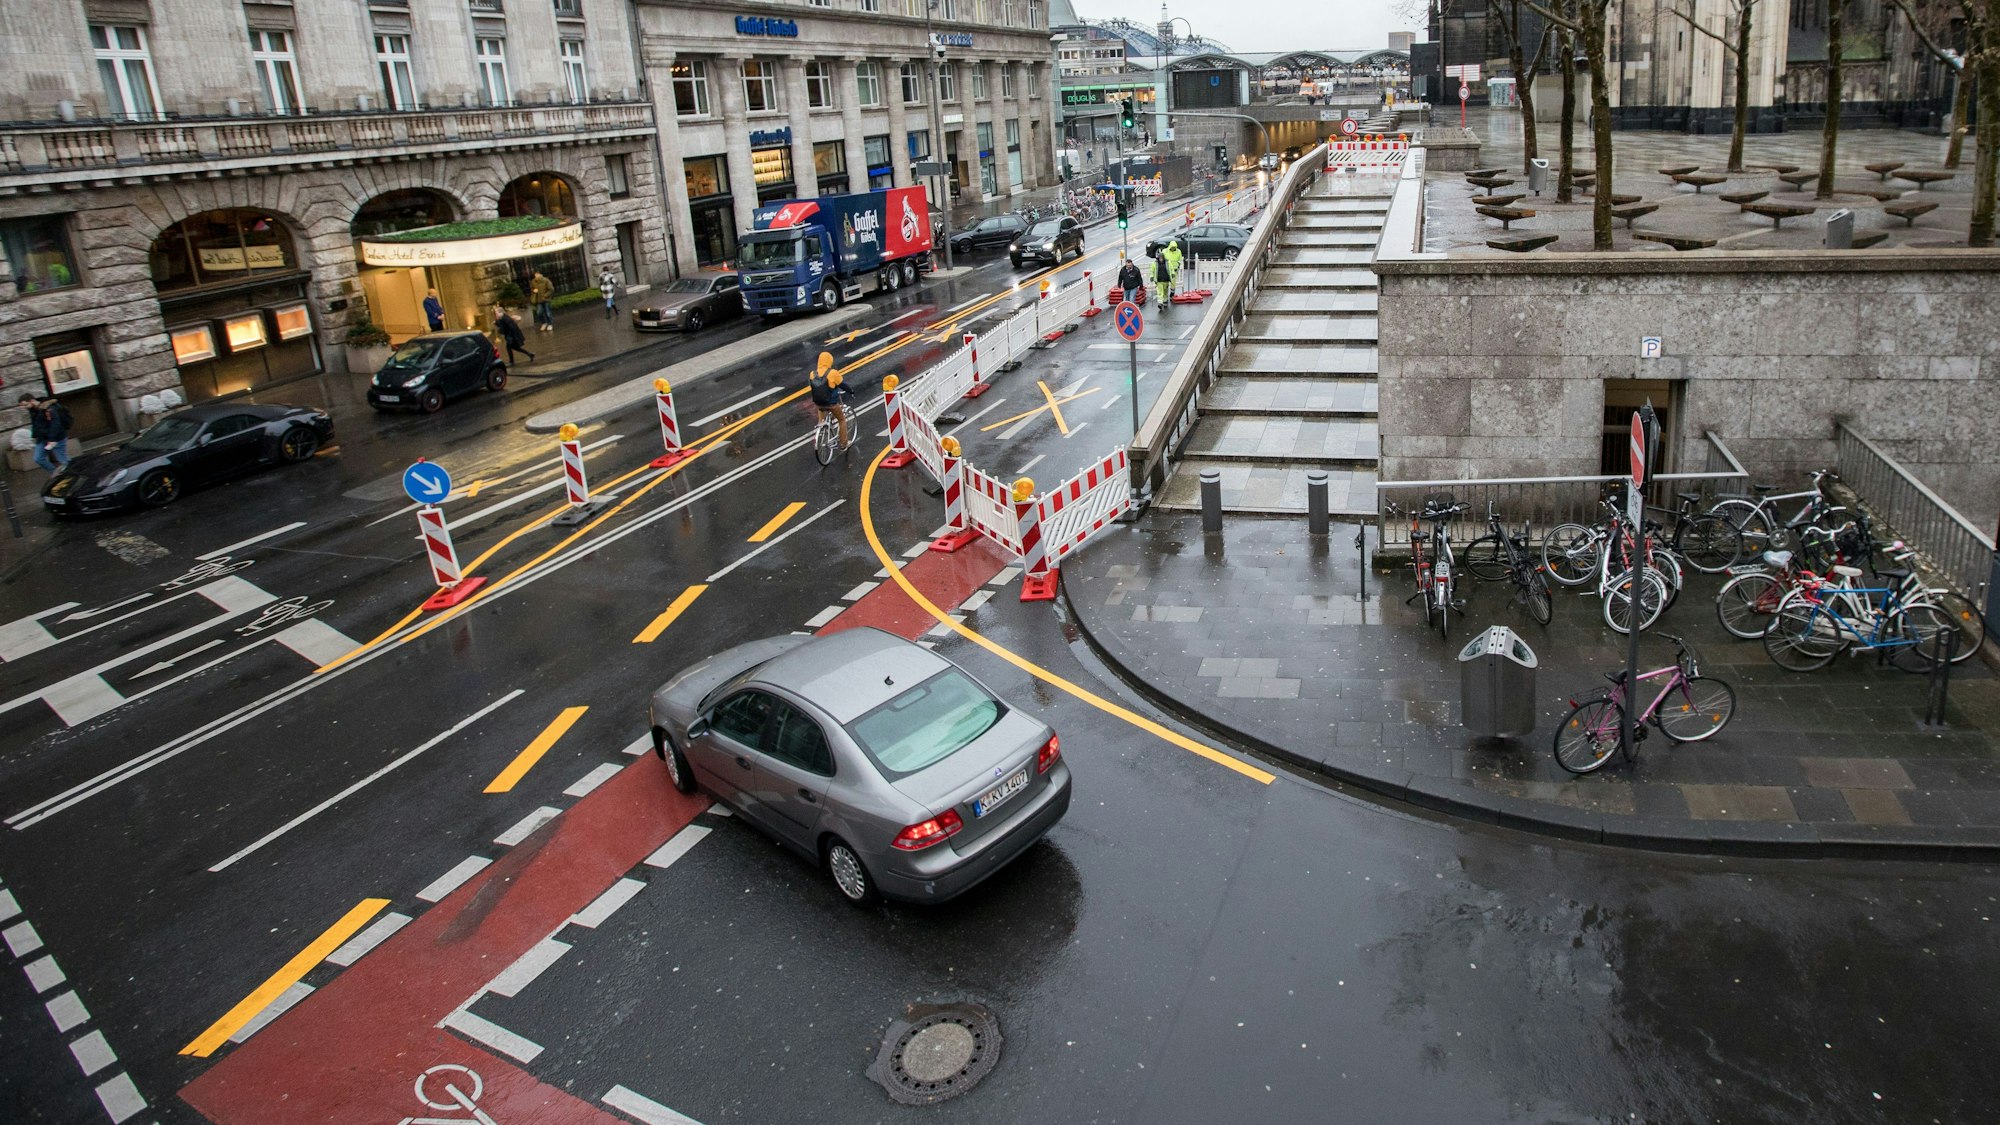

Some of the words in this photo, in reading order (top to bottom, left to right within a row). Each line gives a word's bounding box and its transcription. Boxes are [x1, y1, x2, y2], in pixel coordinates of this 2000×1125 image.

[1210, 75, 1220, 87] U
[1067, 94, 1096, 102] DOUGLAS
[853, 209, 880, 235] Gaffel
[521, 236, 557, 250] Excelsior
[388, 247, 415, 260] Hotel
[418, 248, 446, 260] Ernst
[1646, 342, 1658, 356] P
[1004, 771, 1026, 794] 1407
